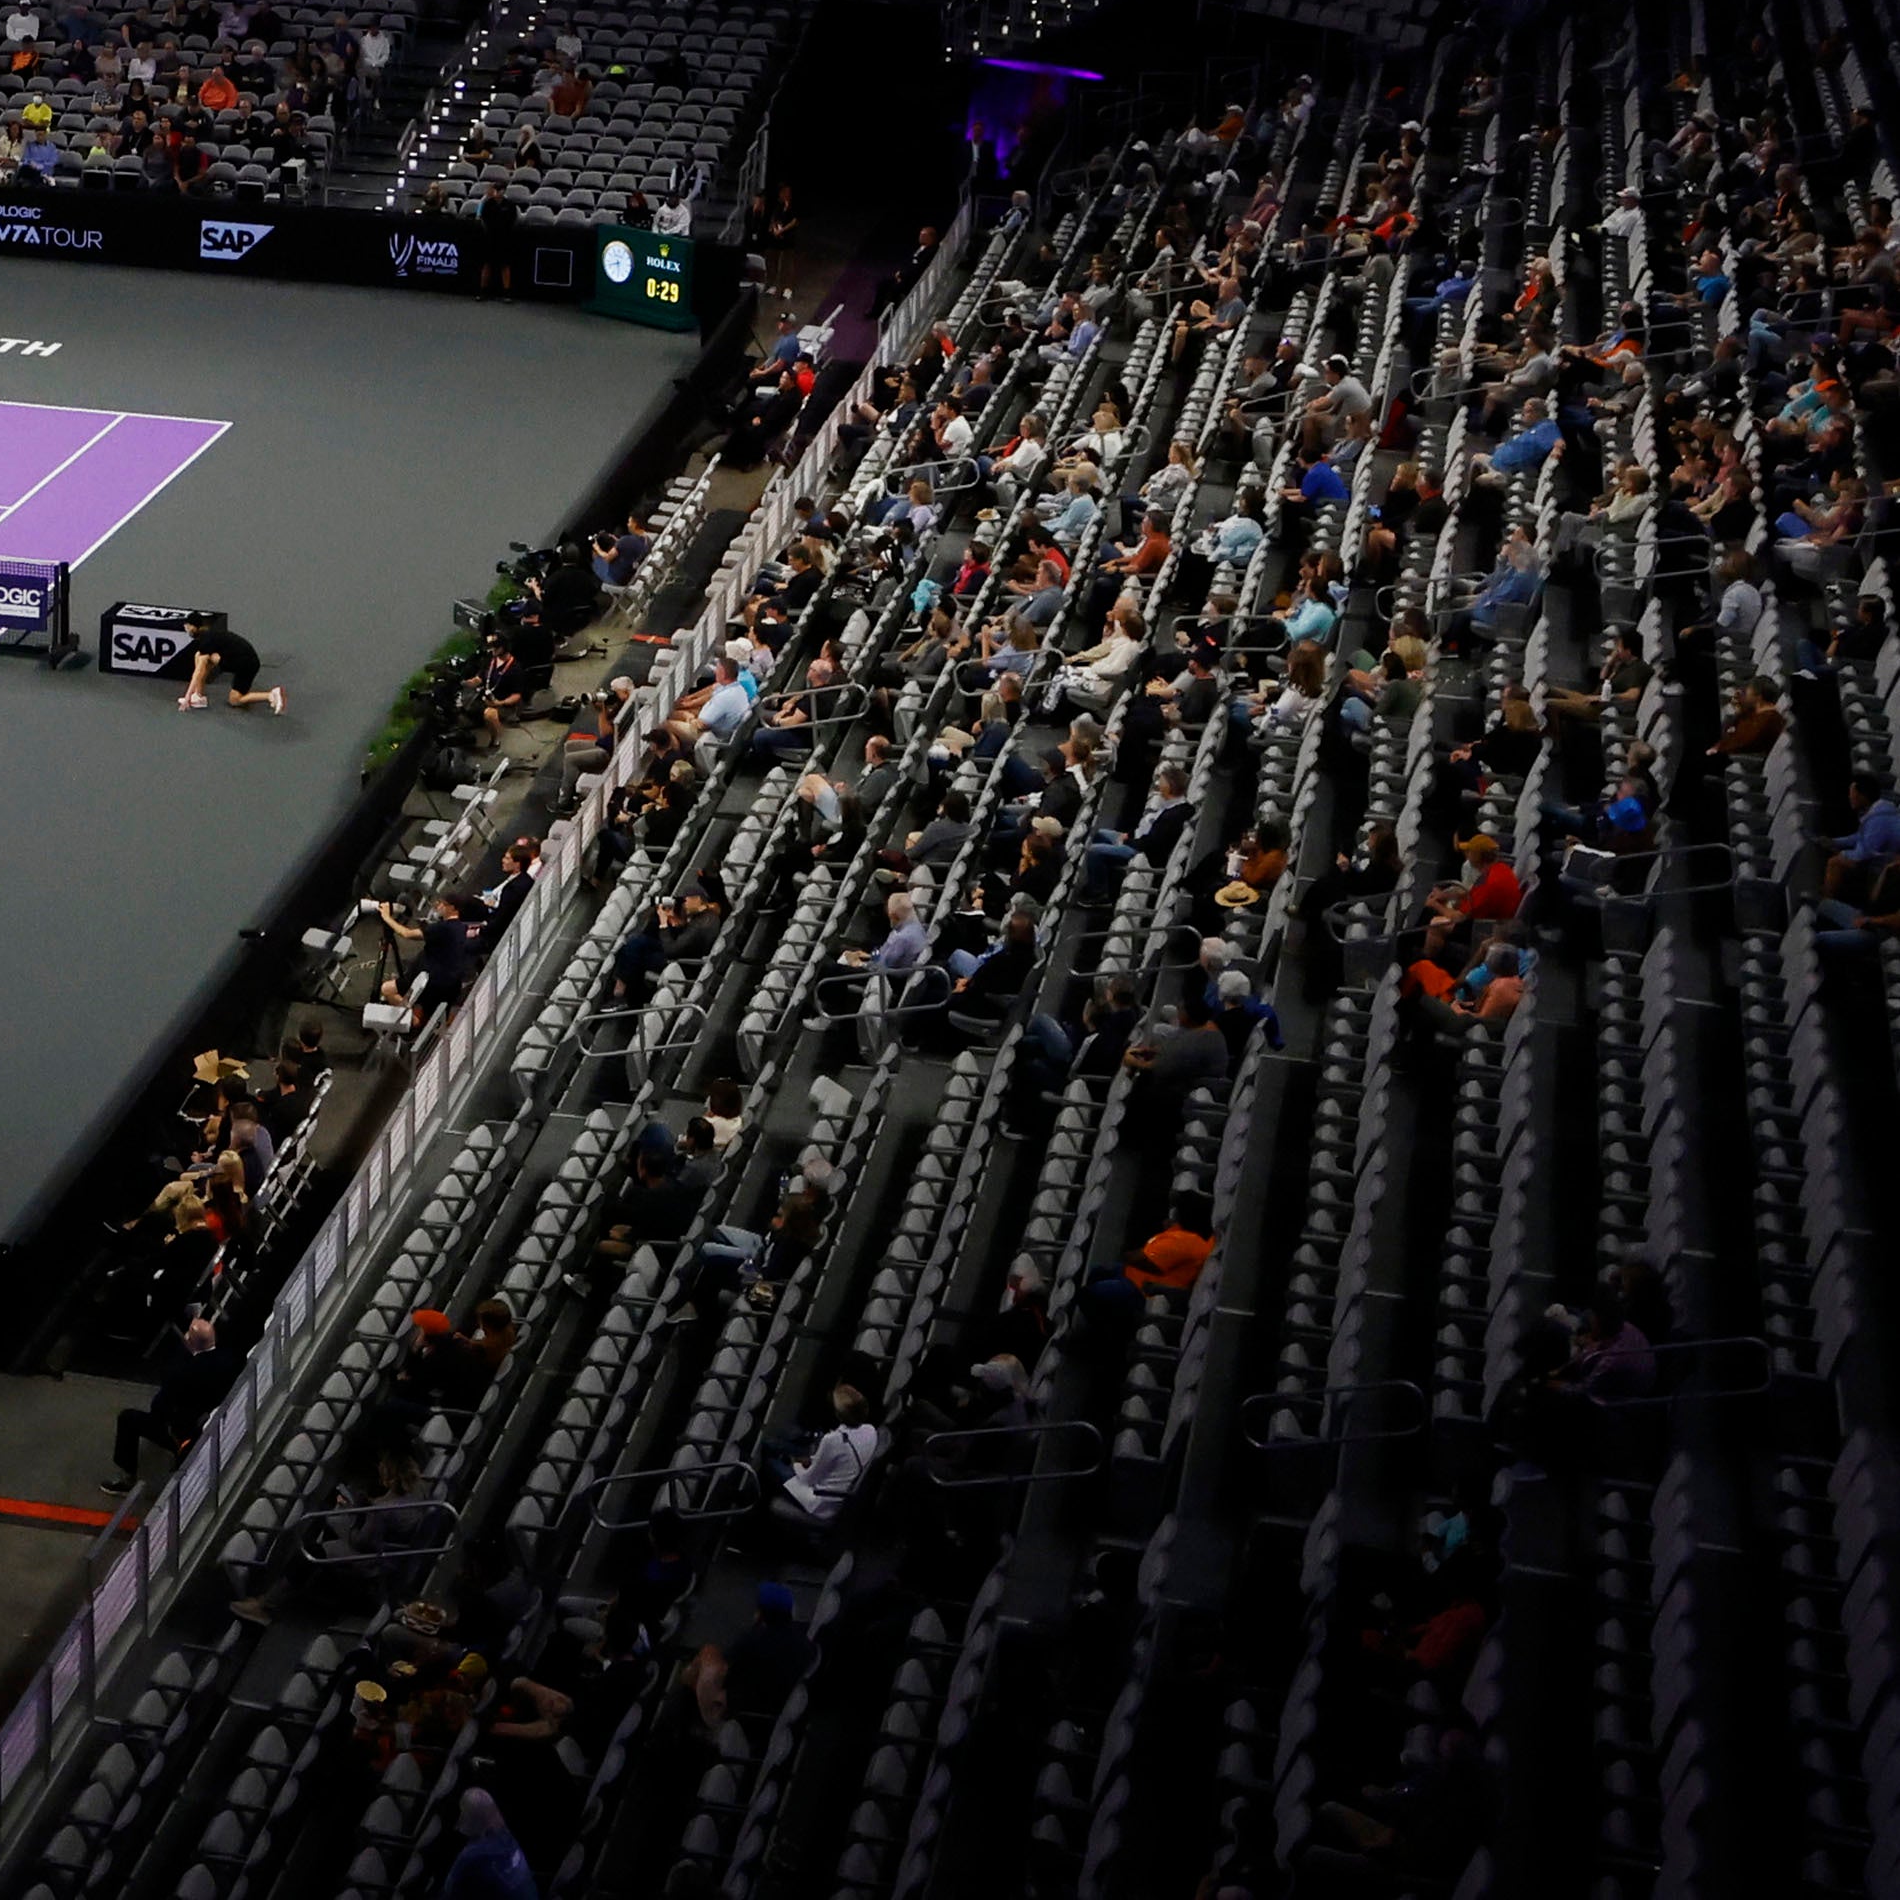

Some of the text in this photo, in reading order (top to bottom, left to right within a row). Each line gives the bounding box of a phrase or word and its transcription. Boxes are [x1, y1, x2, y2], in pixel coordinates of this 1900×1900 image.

[203, 227, 256, 253] SAP
[417, 241, 458, 257] WTA
[416, 255, 458, 268] FINALS
[647, 256, 681, 273] ROLEX
[646, 277, 679, 303] 0:29
[113, 633, 177, 664] SAP
